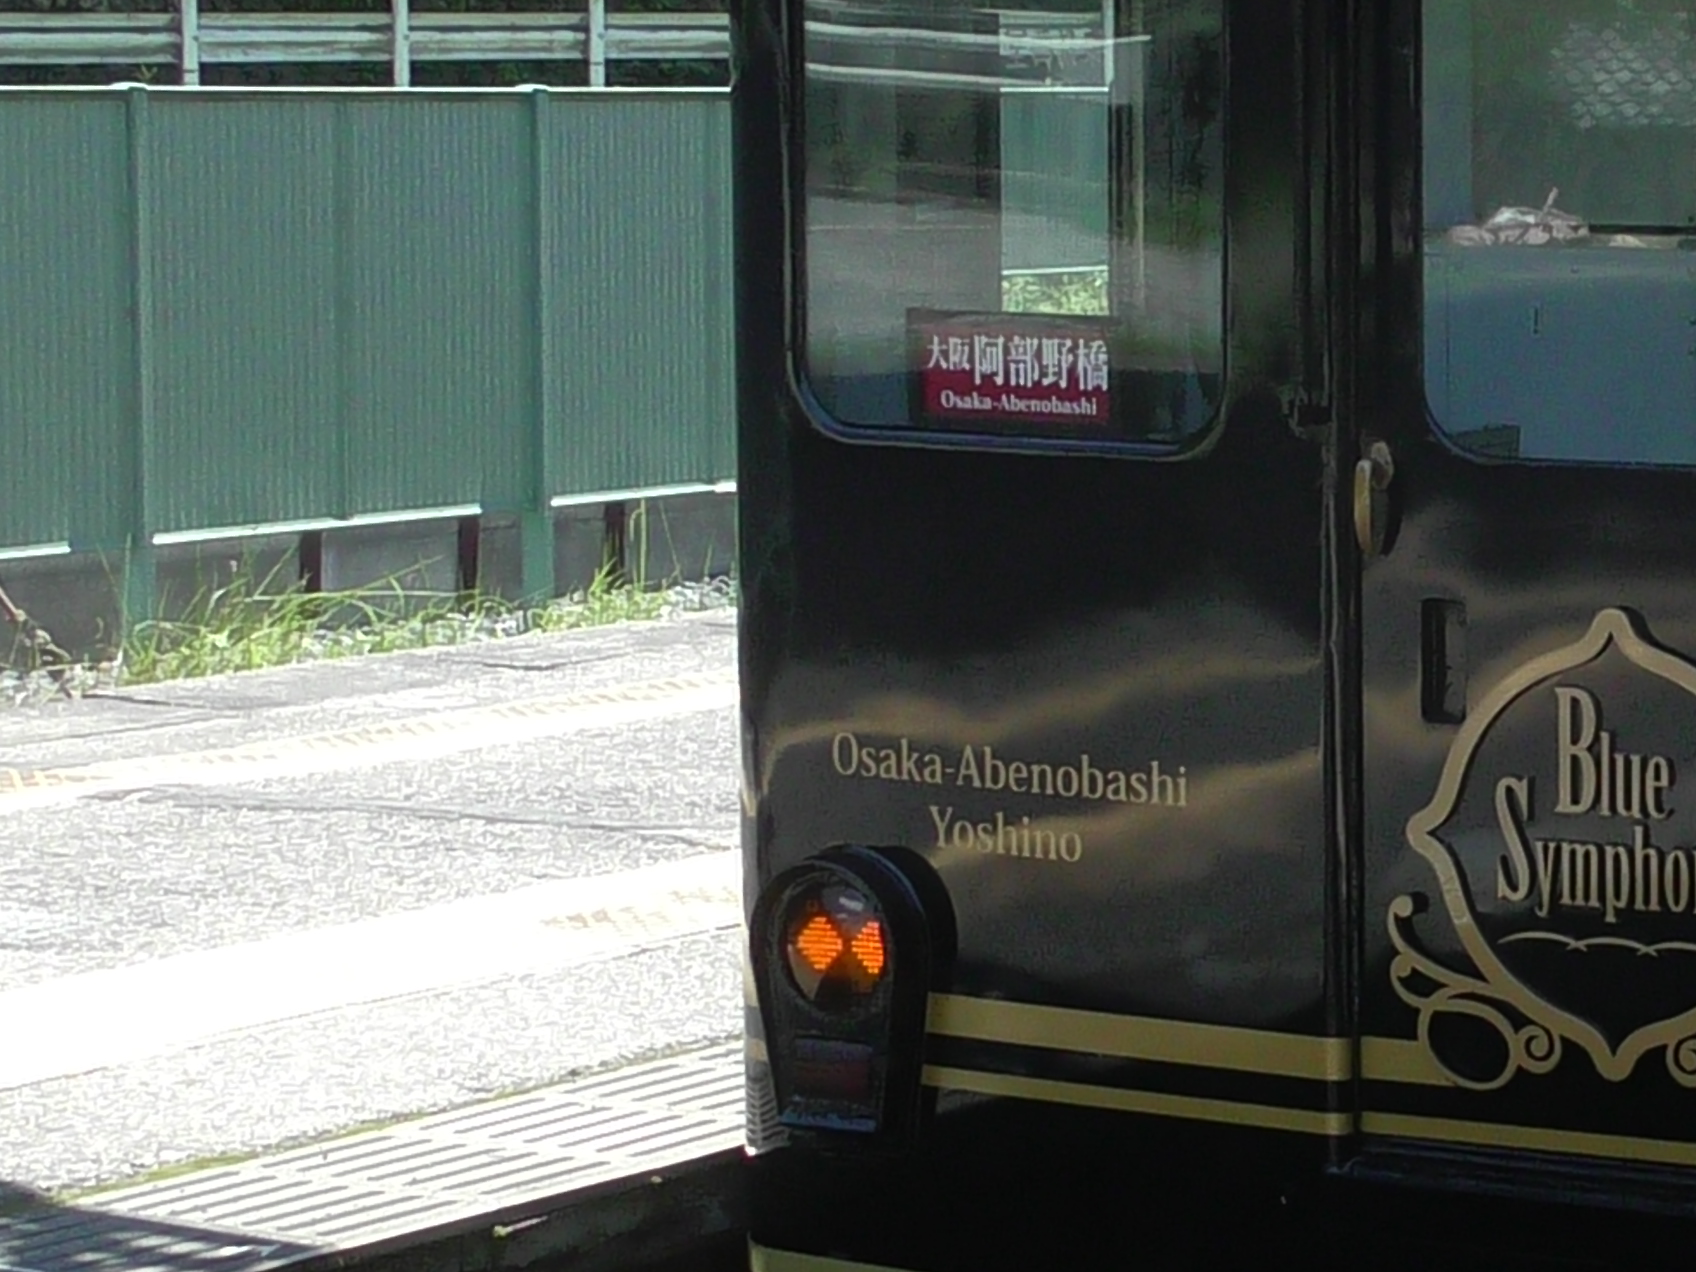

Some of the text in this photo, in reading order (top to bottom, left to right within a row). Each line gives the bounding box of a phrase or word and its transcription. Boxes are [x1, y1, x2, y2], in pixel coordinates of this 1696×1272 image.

[926, 334, 1109, 392] 大阪阿部野橋
[940, 388, 1098, 416] Osaka-Abenobashi
[831, 731, 1188, 808] Osaka-Abenobashi
[1553, 685, 1672, 820] Blue
[929, 805, 1083, 863] Yoshino
